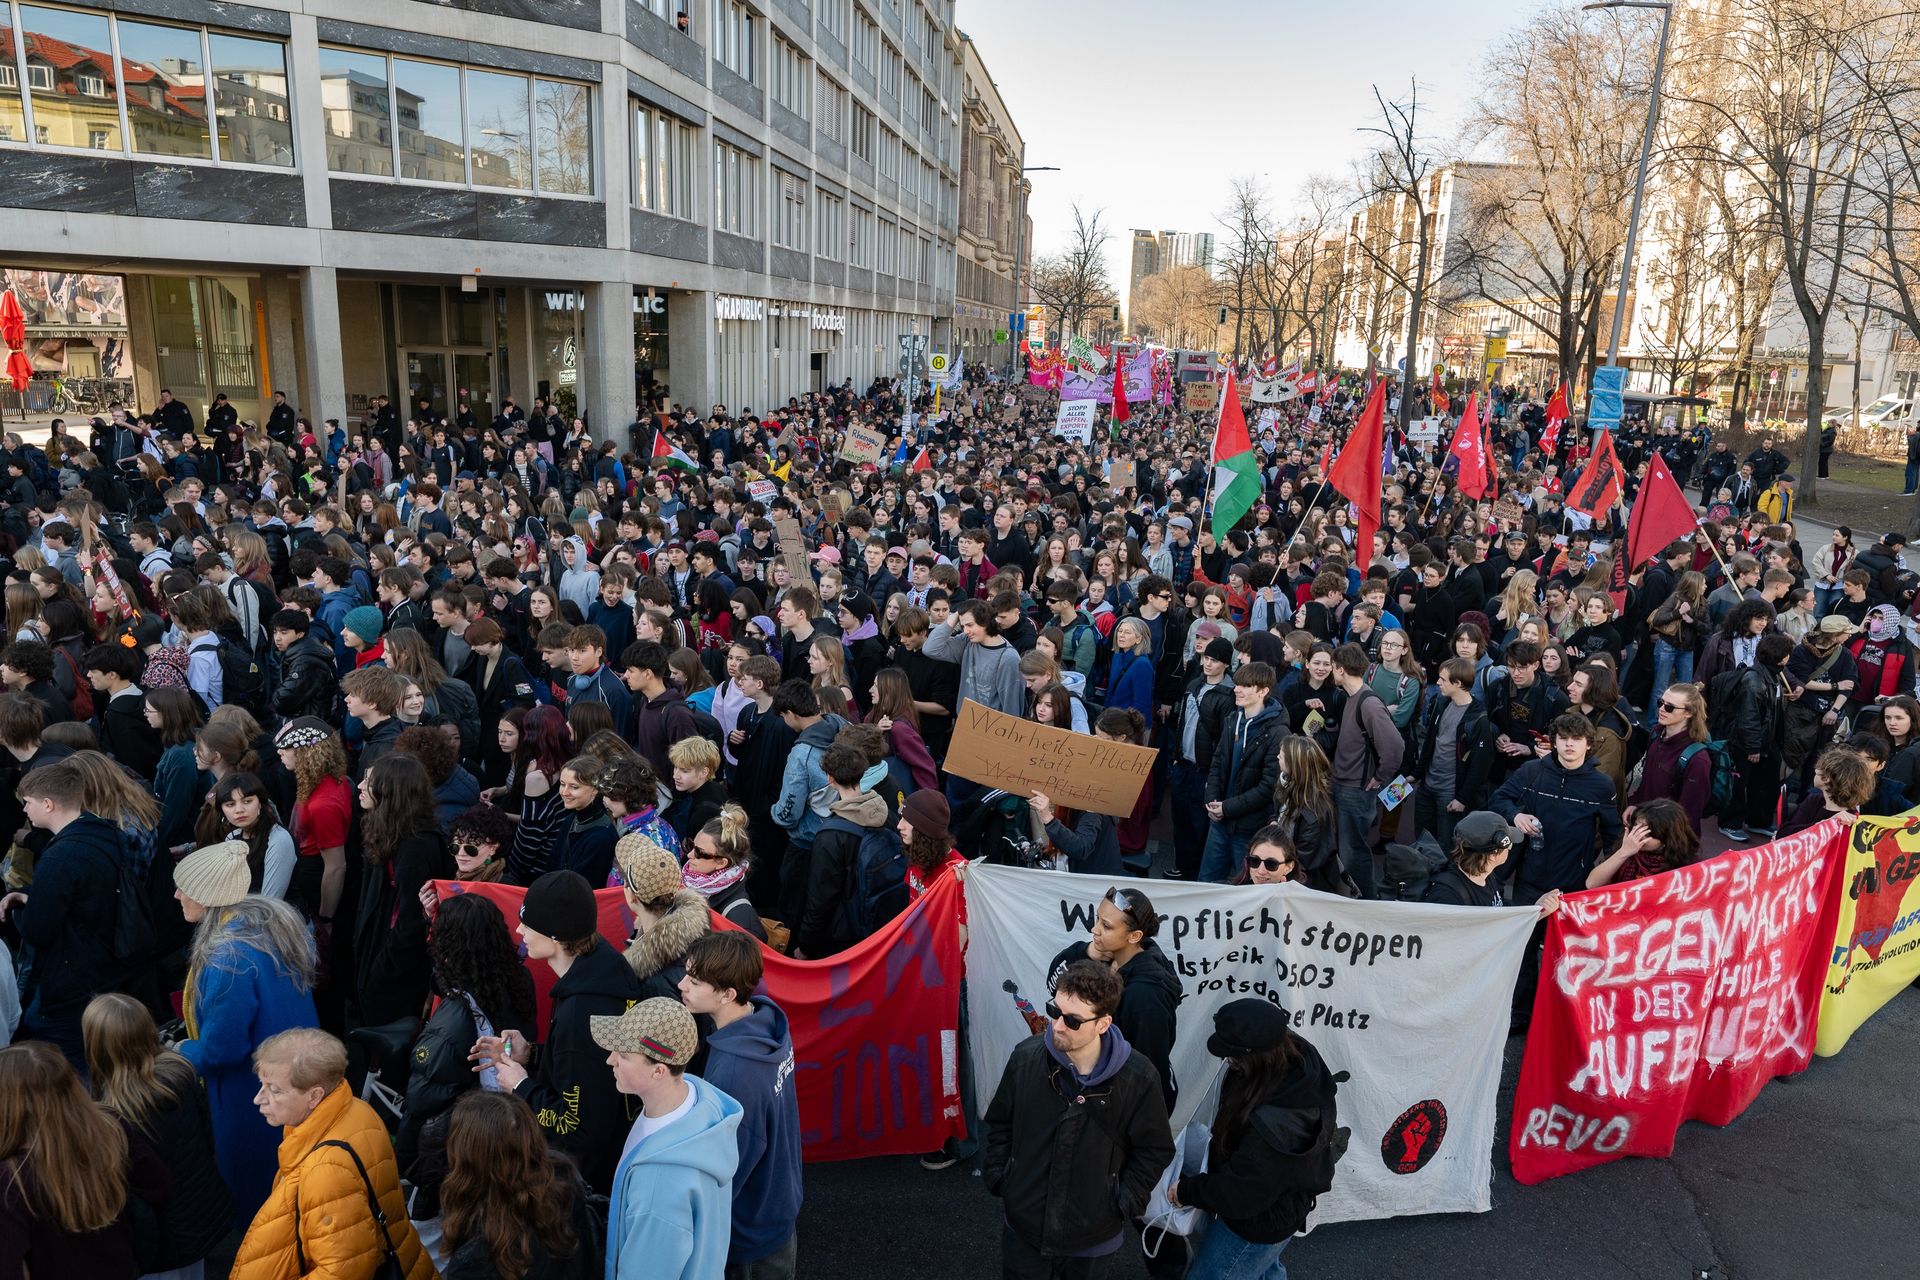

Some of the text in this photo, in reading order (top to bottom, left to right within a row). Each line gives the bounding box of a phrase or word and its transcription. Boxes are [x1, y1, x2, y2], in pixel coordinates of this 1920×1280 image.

[716, 297, 762, 321] WRAPUBLIC
[812, 308, 846, 336] foodbag
[935, 359, 943, 367] H
[1189, 399, 1211, 408] FRONT
[852, 428, 879, 447] Rheingau
[854, 440, 873, 451] gegen
[1029, 753, 1073, 776] statt
[1557, 879, 1653, 927] NICHT
[1660, 861, 1730, 904] AUF
[1555, 857, 1824, 996] GEGENMACHT
[1301, 921, 1422, 965] stoppen
[1311, 1003, 1370, 1029] Platz
[1590, 993, 1616, 1034] IN
[1632, 981, 1694, 1023] DER
[1519, 1104, 1633, 1153] REVO
